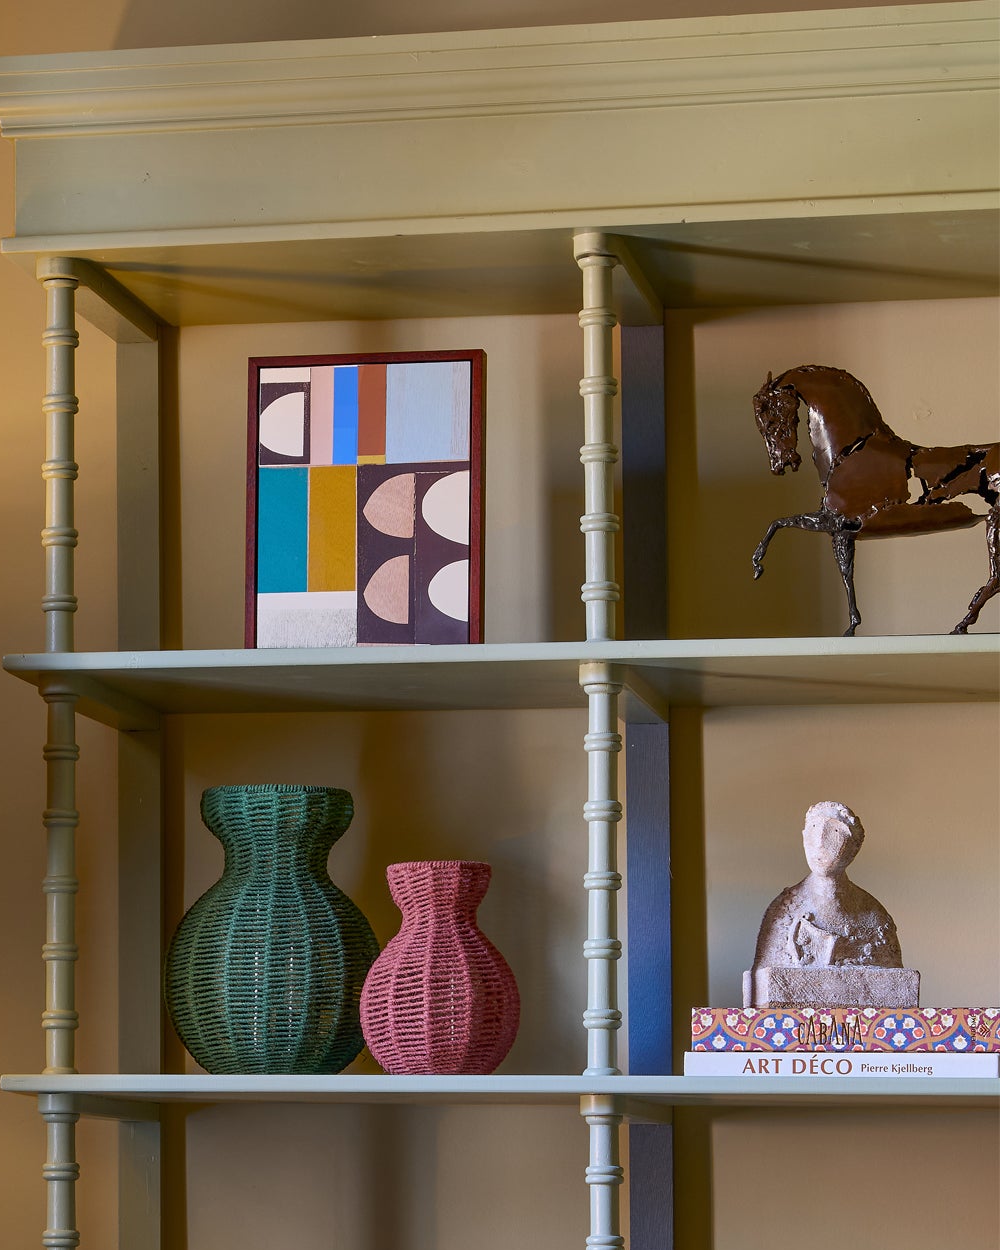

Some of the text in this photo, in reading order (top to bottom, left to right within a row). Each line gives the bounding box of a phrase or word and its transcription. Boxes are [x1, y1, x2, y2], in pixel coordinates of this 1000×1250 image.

[798, 1015, 863, 1046] CABANA
[742, 1054, 853, 1075] ART DÉCO
[861, 1063, 933, 1075] Pierre Kjellberg
